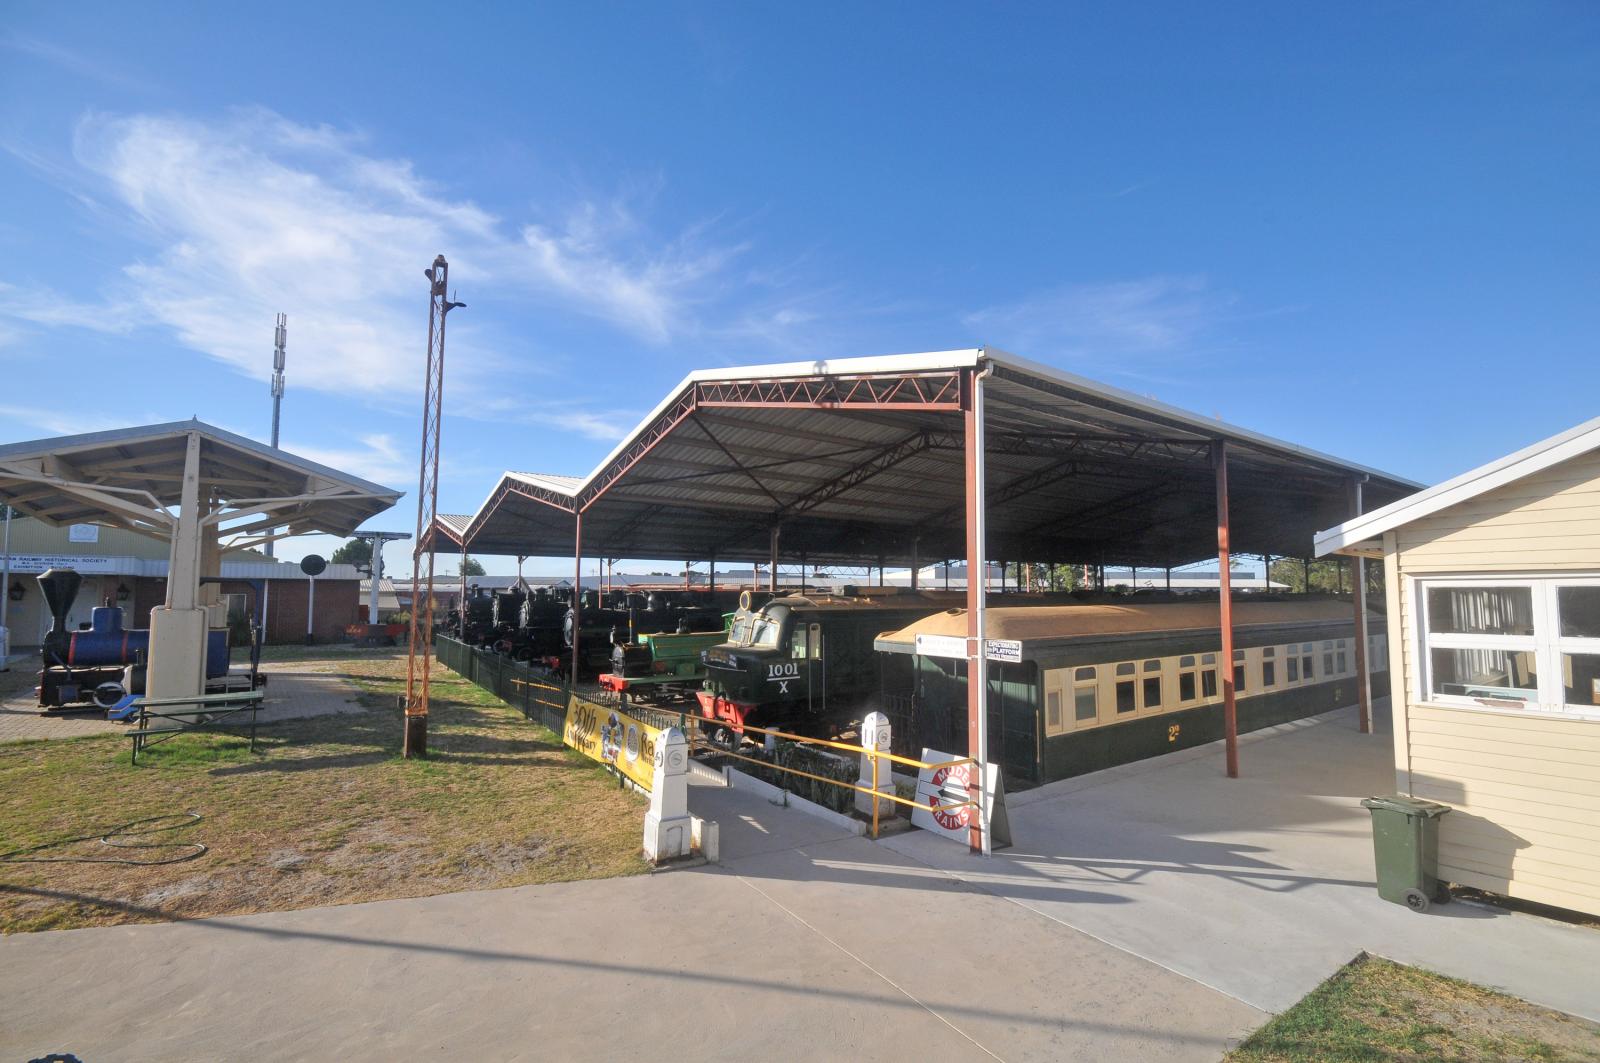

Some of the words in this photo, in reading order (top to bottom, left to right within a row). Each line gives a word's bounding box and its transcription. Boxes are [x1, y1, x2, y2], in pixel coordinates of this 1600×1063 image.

[992, 647, 1020, 656] PLATFORM
[769, 663, 798, 677] 1001
[780, 681, 789, 693] X
